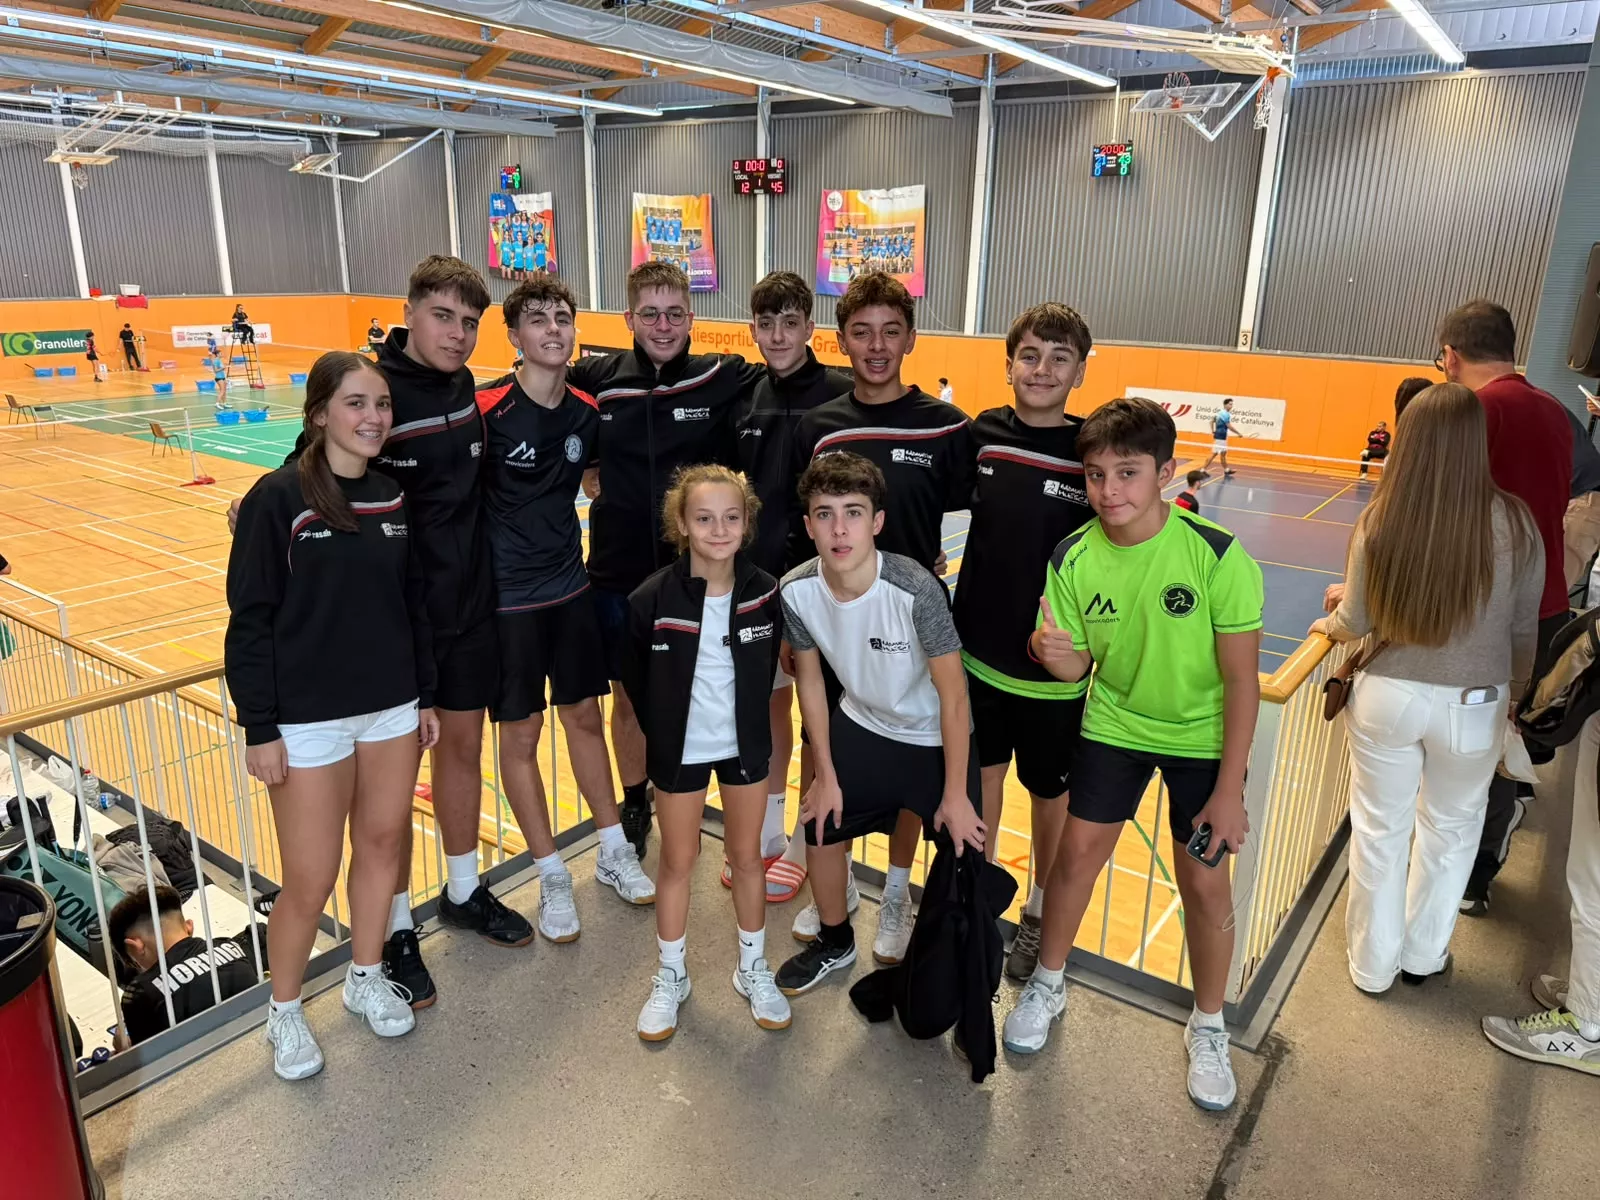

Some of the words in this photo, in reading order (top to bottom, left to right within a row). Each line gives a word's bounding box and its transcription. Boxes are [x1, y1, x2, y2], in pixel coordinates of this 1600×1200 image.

[741, 182, 750, 193] 12
[771, 181, 783, 193] 45
[692, 326, 754, 348] liesportiu
[1241, 334, 1248, 345] 3
[1231, 409, 1262, 418] deracions
[1241, 417, 1275, 427] Catalunya
[53, 885, 97, 938] YON
